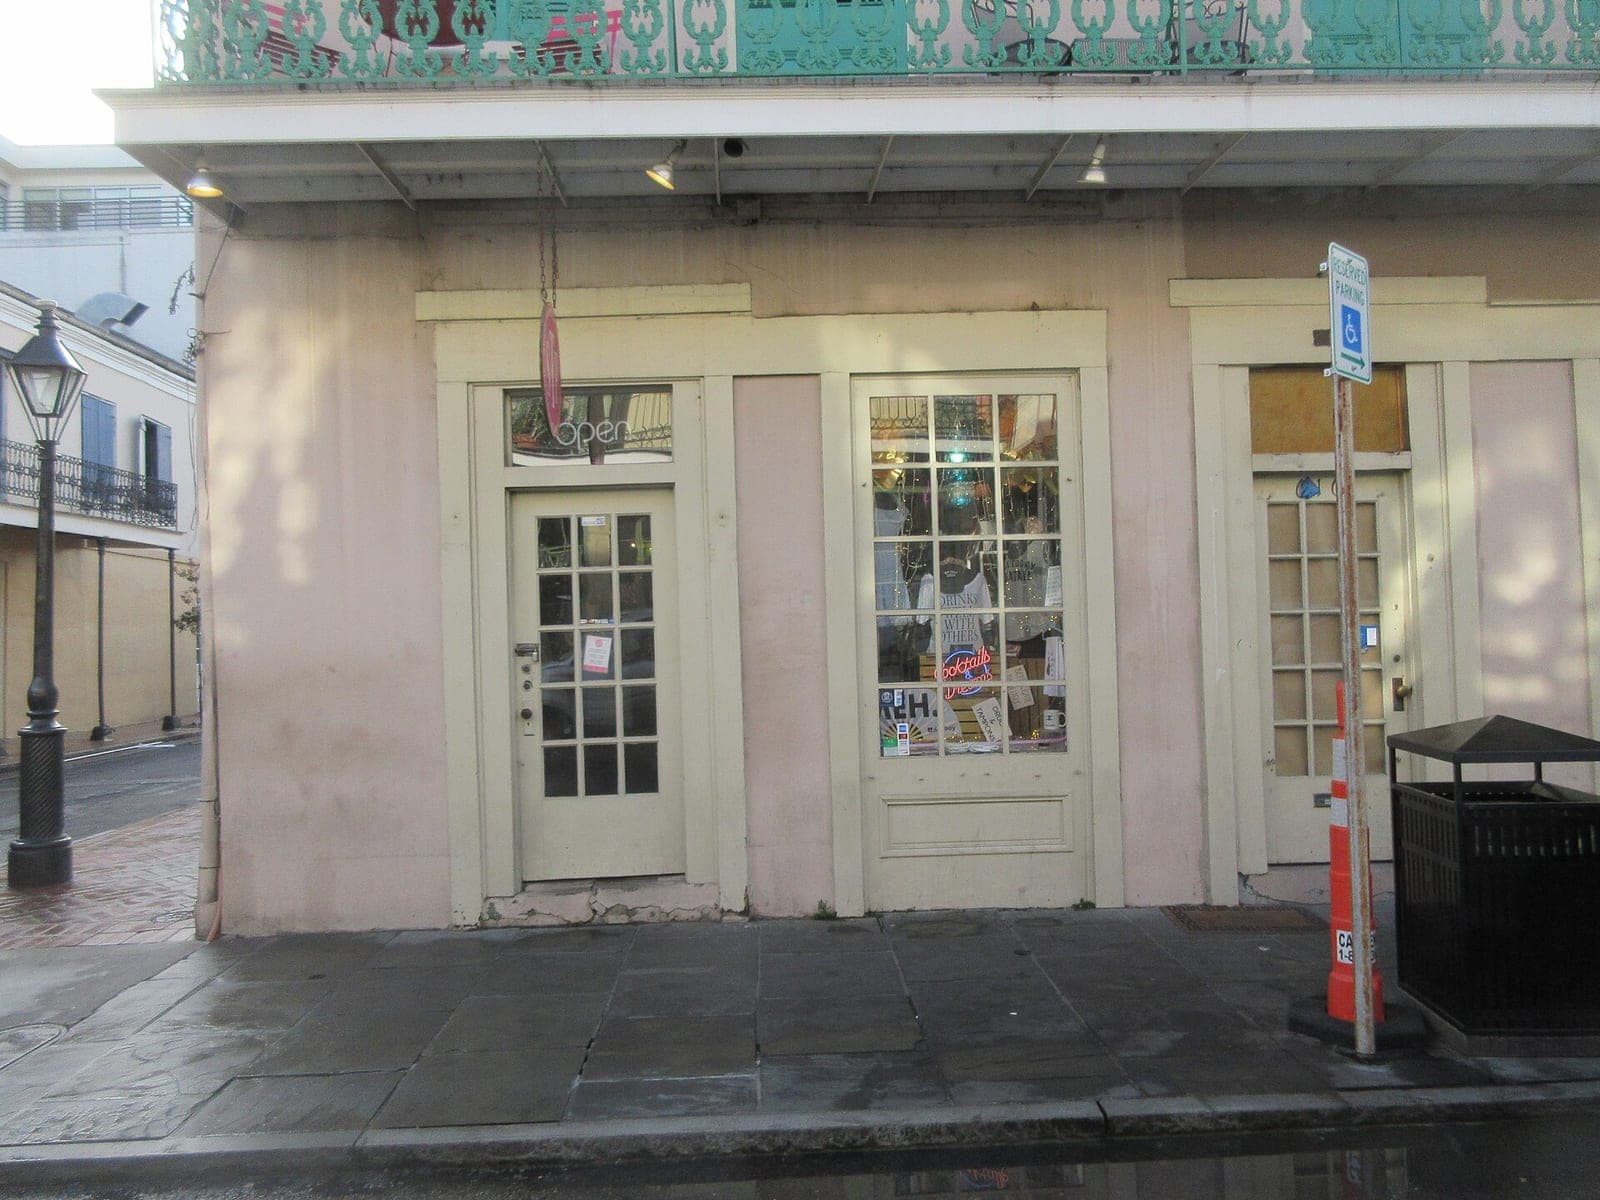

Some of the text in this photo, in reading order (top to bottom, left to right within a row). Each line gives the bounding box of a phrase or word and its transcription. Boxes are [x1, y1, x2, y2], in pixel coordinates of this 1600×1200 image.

[1331, 256, 1366, 286] RESERVED
[1335, 280, 1365, 306] PARKING
[557, 421, 631, 451] open
[944, 617, 976, 630] WITH
[944, 673, 993, 700] Drems
